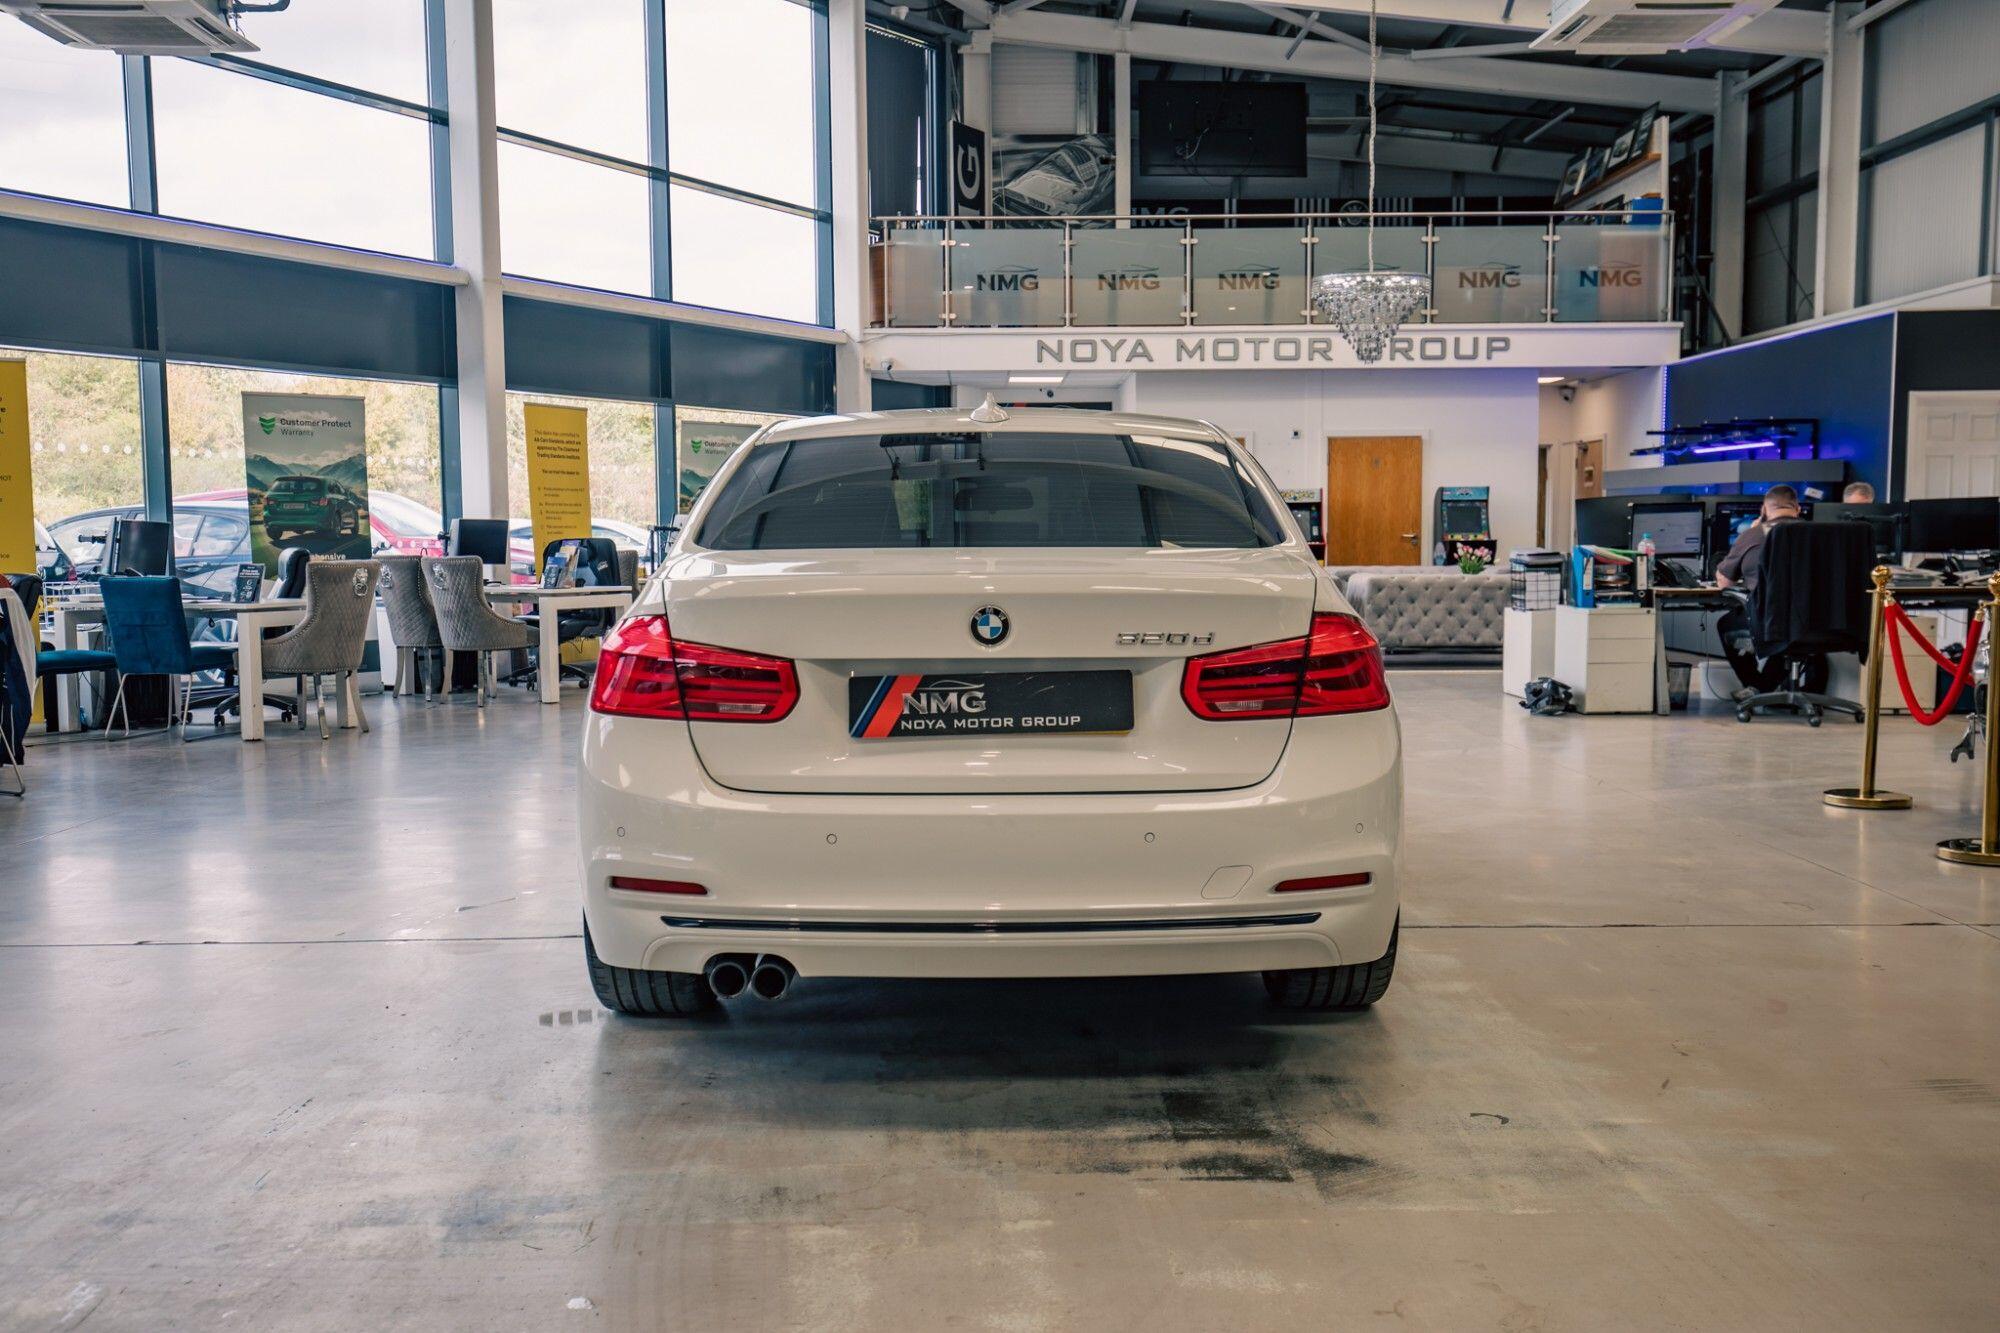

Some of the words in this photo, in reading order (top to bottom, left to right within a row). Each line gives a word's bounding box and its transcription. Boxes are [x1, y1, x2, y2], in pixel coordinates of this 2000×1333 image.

[977, 273, 1039, 291] NMG
[1097, 273, 1160, 291] NMG
[1218, 273, 1280, 291] NMG
[1458, 271, 1520, 289] NMG
[1579, 270, 1641, 287] NMG
[1037, 338, 1153, 363] NOYA
[1176, 337, 1334, 362] MOTOR
[1357, 336, 1510, 362] ROUP
[280, 418, 320, 427] Customer
[321, 419, 352, 428] Protect
[281, 428, 314, 437] Warranty
[1117, 631, 1215, 647] 320d
[902, 691, 987, 715] NMG
[901, 719, 946, 730] NOYA
[954, 717, 1014, 729] MOTOR
[1022, 715, 1081, 727] GROUP
